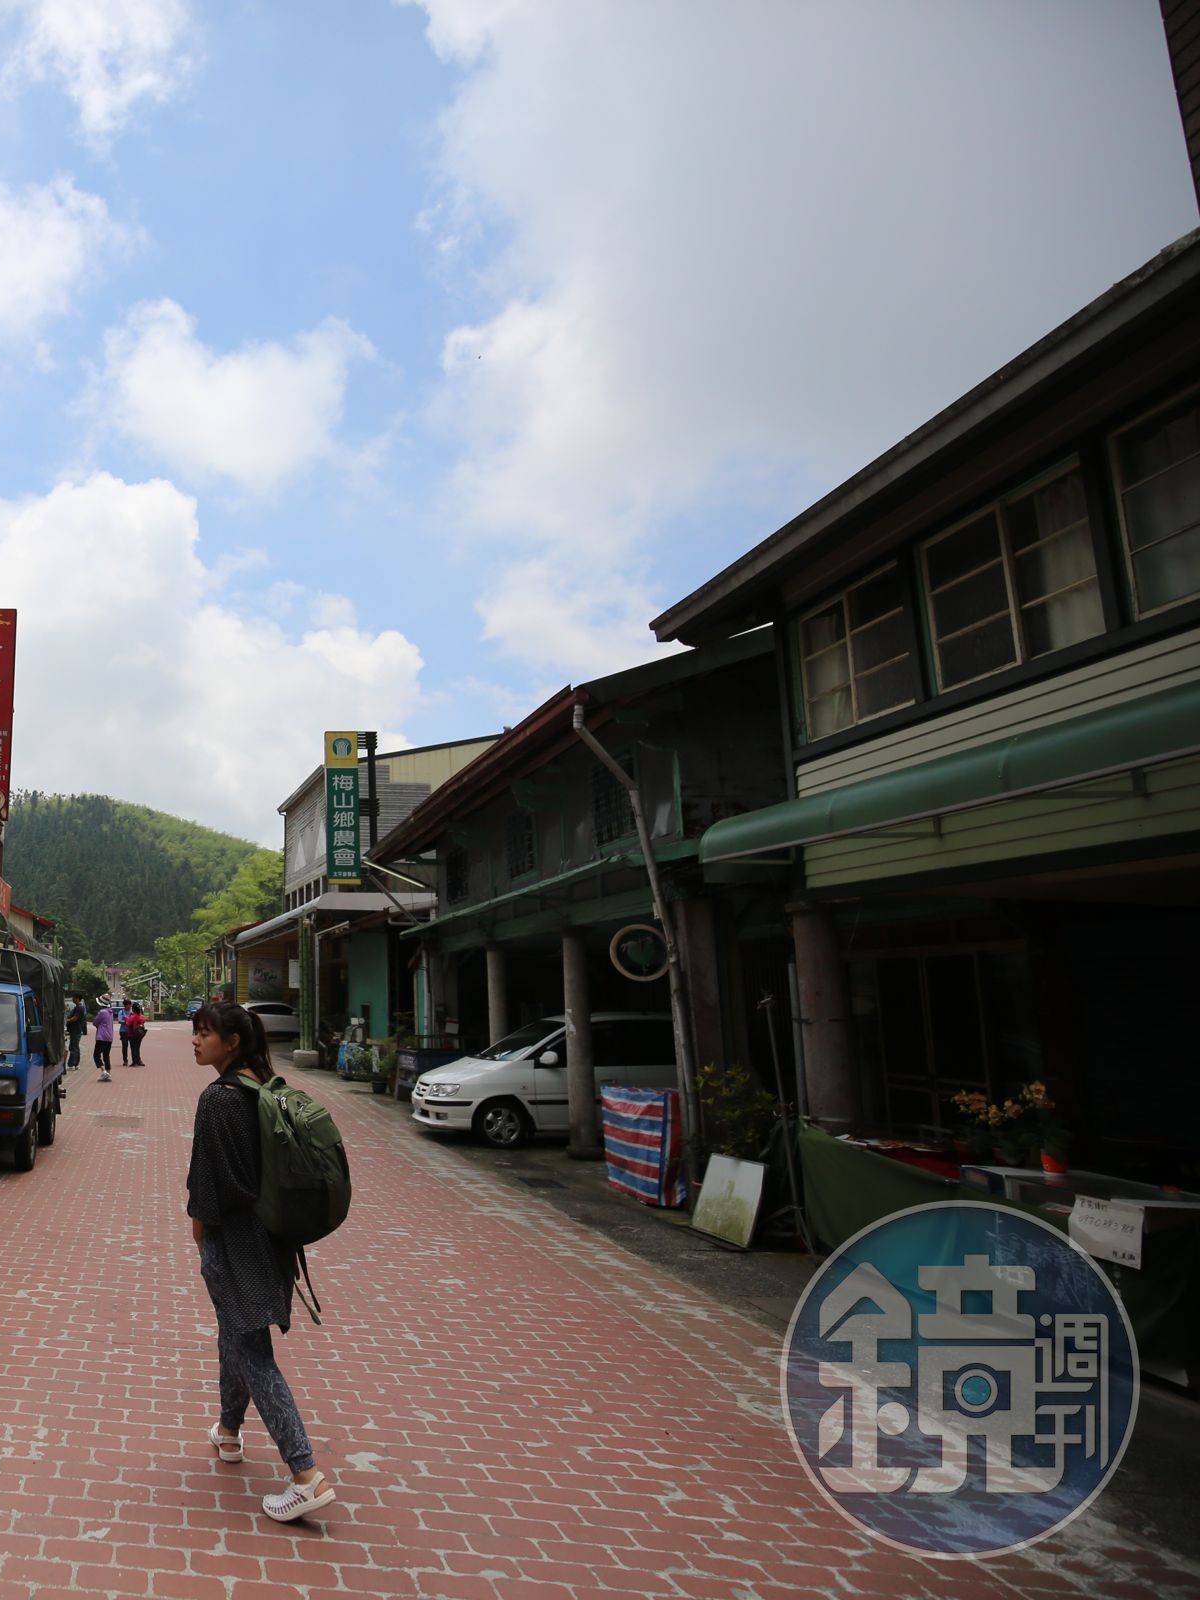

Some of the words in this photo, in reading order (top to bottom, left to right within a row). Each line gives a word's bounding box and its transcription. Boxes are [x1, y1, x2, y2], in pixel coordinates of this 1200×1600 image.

[332, 774, 356, 866] 梅山鄉農會
